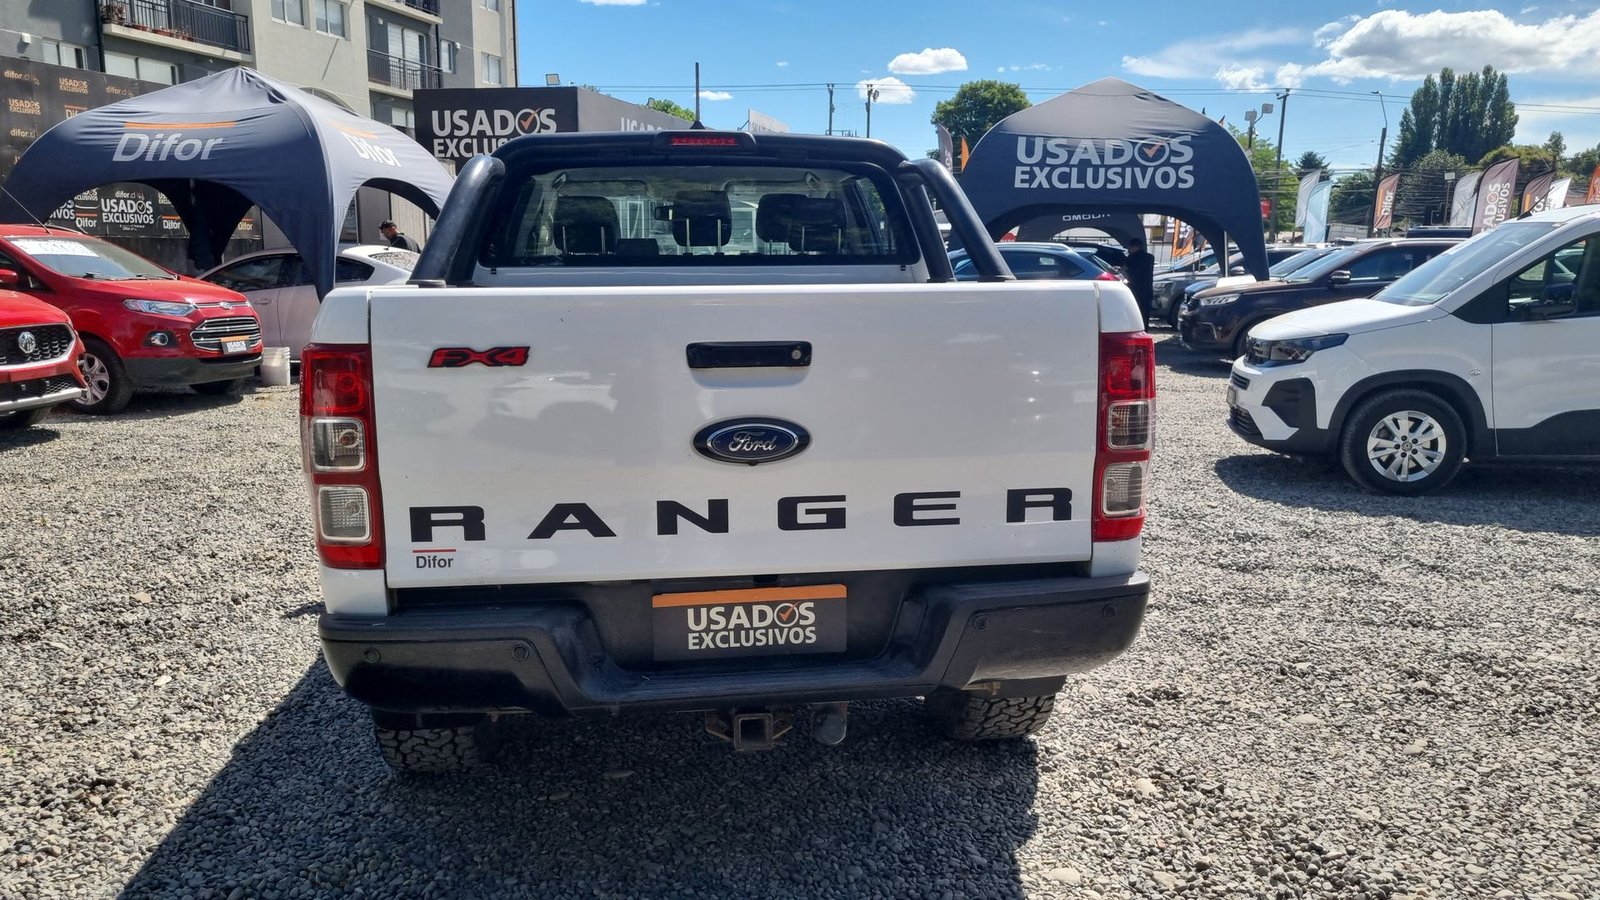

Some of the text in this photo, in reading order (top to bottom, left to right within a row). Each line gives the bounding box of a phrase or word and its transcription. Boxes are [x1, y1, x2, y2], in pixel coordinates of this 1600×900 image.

[431, 108, 558, 137] USADOS
[112, 133, 223, 162] Difor
[340, 131, 402, 167] Difor
[1015, 135, 1194, 166] USADOS
[1014, 165, 1195, 189] EXCLUSIVOS
[101, 199, 153, 214] USADOS
[102, 213, 154, 224] EXCLUSIVOS
[76, 217, 97, 228] Difor
[163, 220, 181, 229] Difor
[427, 346, 530, 368] FX4
[728, 431, 778, 452] Ford
[409, 487, 1073, 542] RANGER
[415, 555, 454, 569] Difor
[687, 601, 815, 632] USADOS
[687, 625, 817, 650] EXCLUSIVOS
